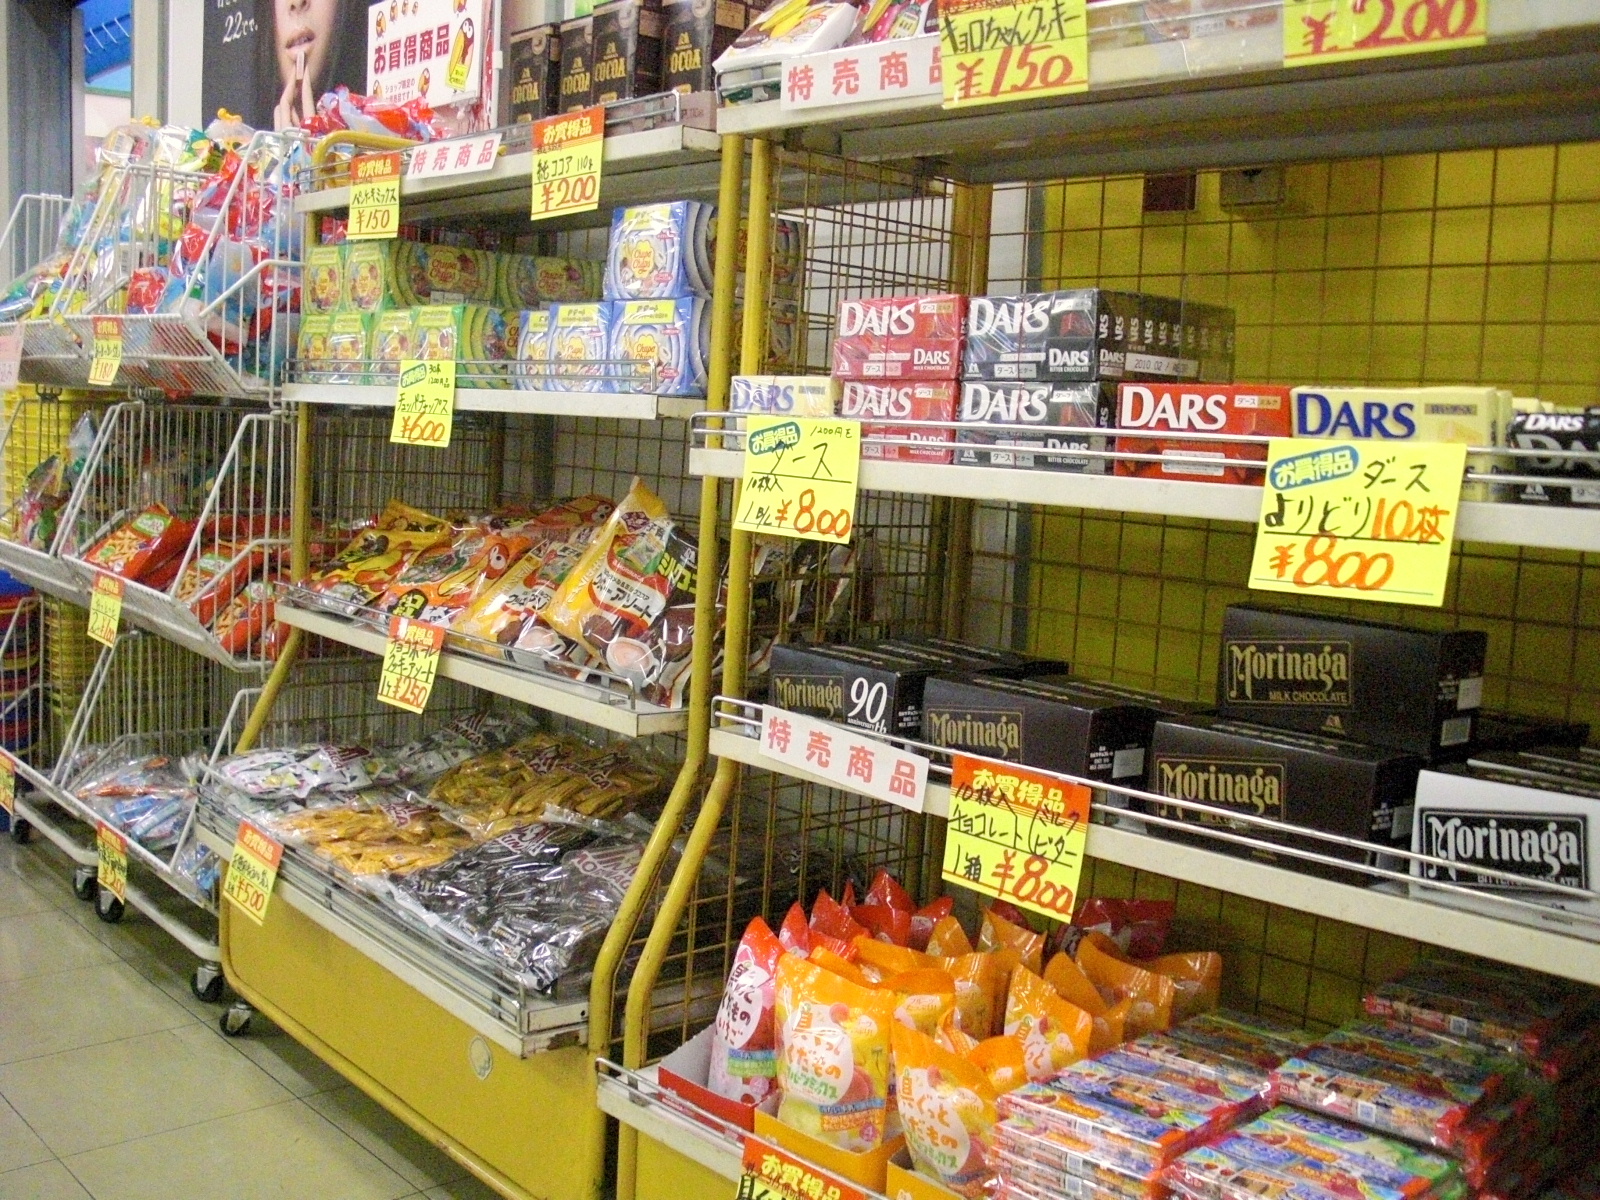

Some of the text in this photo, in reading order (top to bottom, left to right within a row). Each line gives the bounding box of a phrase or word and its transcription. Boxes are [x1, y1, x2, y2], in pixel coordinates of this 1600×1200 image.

[1302, 0, 1478, 54] ¥200
[373, 23, 450, 75] お買得商品
[562, 72, 591, 95] COCOA
[593, 57, 626, 82] COCOA
[954, 44, 1074, 98] ¥150
[512, 85, 539, 104] COCOA
[543, 117, 592, 143] お買得品
[358, 159, 392, 177] お買得品
[412, 139, 495, 174] 特売商品
[540, 175, 597, 212] ¥200
[356, 209, 391, 232] ¥150
[840, 302, 916, 336] DARS
[969, 298, 1051, 336] DARS
[914, 348, 950, 365] DARS
[997, 366, 1015, 375] ダース
[1049, 348, 1089, 366] DARS
[1100, 349, 1124, 363] DARS
[733, 379, 794, 412] DARS
[842, 381, 913, 418] DARS
[962, 382, 1048, 422] DARS
[1121, 386, 1227, 431] DARS
[1237, 397, 1256, 405] ダース
[400, 411, 446, 443] ¥600
[1297, 393, 1416, 439] DARS
[1524, 414, 1584, 431] DARS
[752, 425, 798, 453] お買得品
[993, 452, 1012, 462] ダース
[1274, 449, 1431, 492] お買得品 ダース
[775, 489, 851, 539] ¥800
[1269, 533, 1394, 591] ¥800
[1229, 644, 1349, 703] Morinaga
[393, 676, 428, 708] ¥250
[775, 677, 843, 717] Morinaga
[847, 677, 888, 724] 90
[1293, 692, 1348, 704] CHOCOLATE
[874, 719, 887, 734] th
[929, 712, 1021, 757] Morinaga
[768, 716, 916, 798] 特売商品
[972, 768, 1065, 813] お買得品
[1160, 762, 1280, 820] Morinaga
[949, 803, 1080, 849] チョコレート ミルク
[1034, 834, 1077, 865] ビター
[1427, 815, 1580, 882] Morinaga
[236, 876, 265, 911] ¥500
[991, 848, 1074, 914] ¥800
